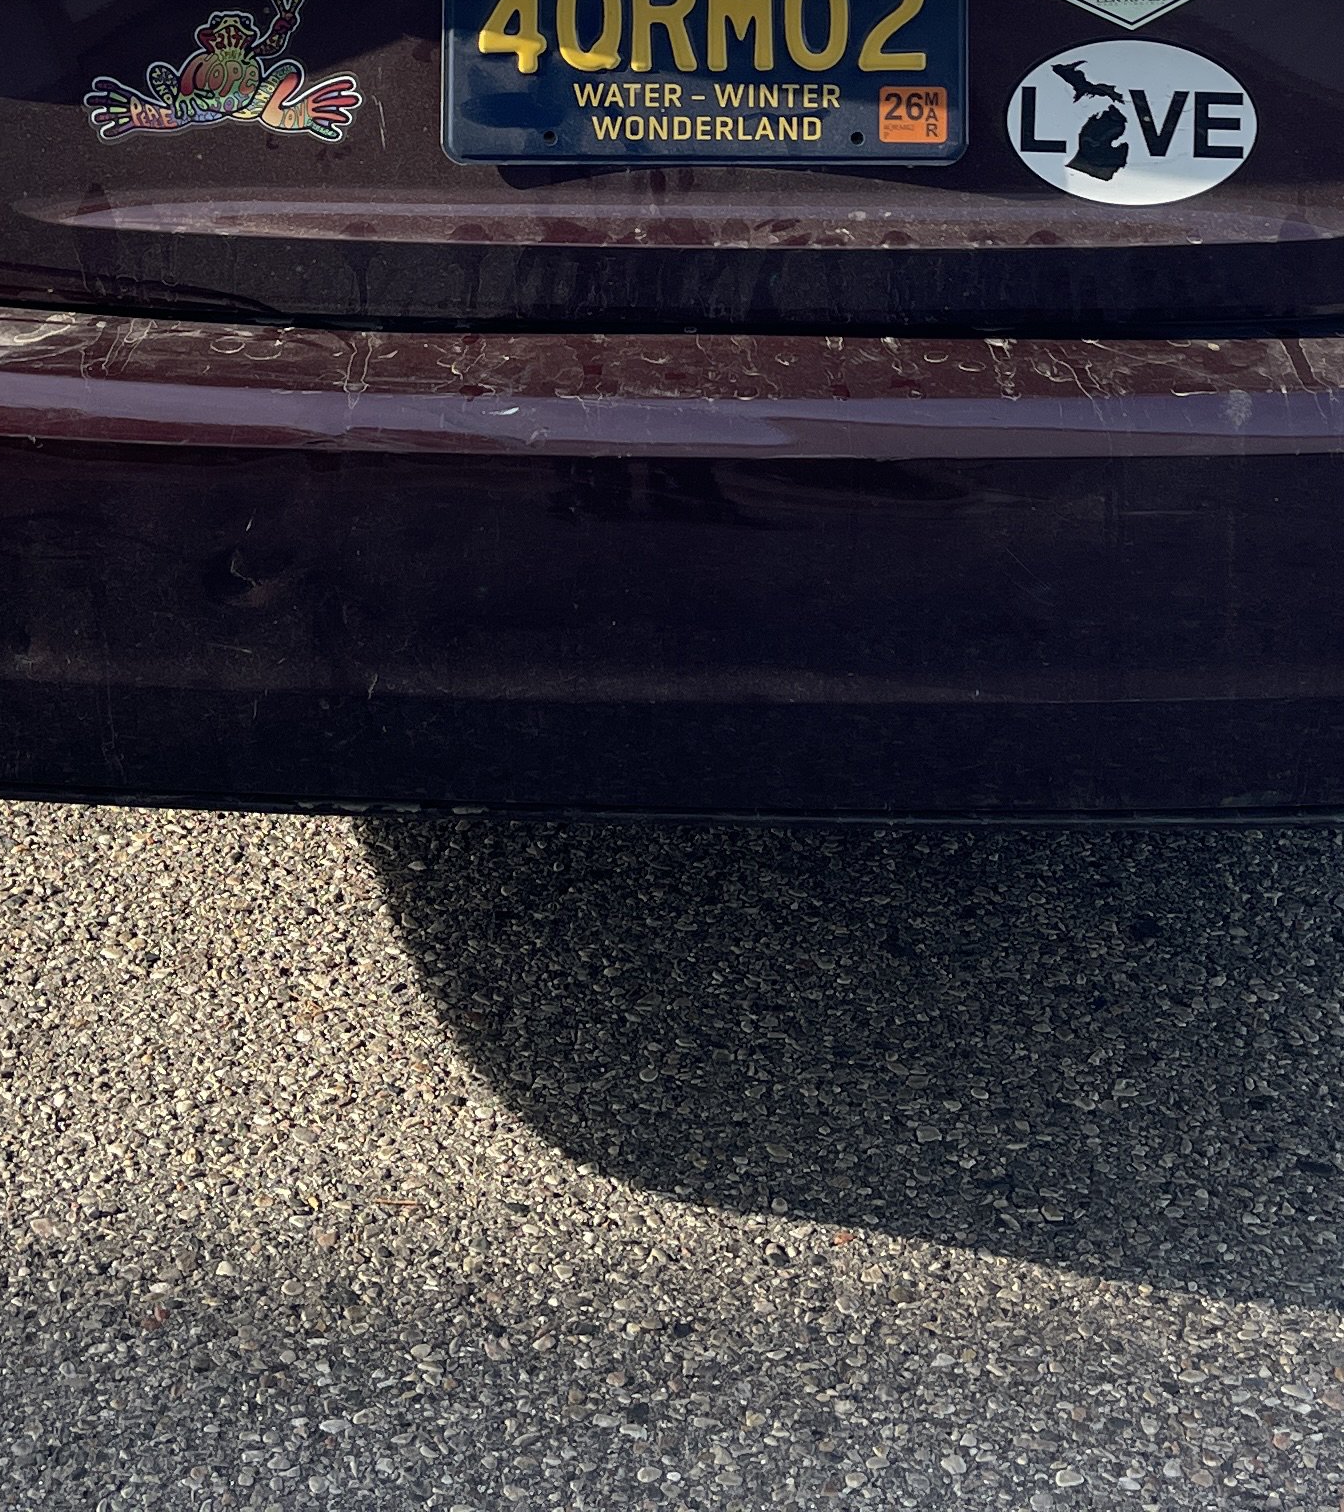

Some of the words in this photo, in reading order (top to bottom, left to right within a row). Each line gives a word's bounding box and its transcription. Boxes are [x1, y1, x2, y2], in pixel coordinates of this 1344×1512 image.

[592, 115, 823, 141] WONDERLAND
[884, 92, 924, 121] 26
[925, 92, 939, 138] MAR
[1020, 86, 1244, 181] LVE
